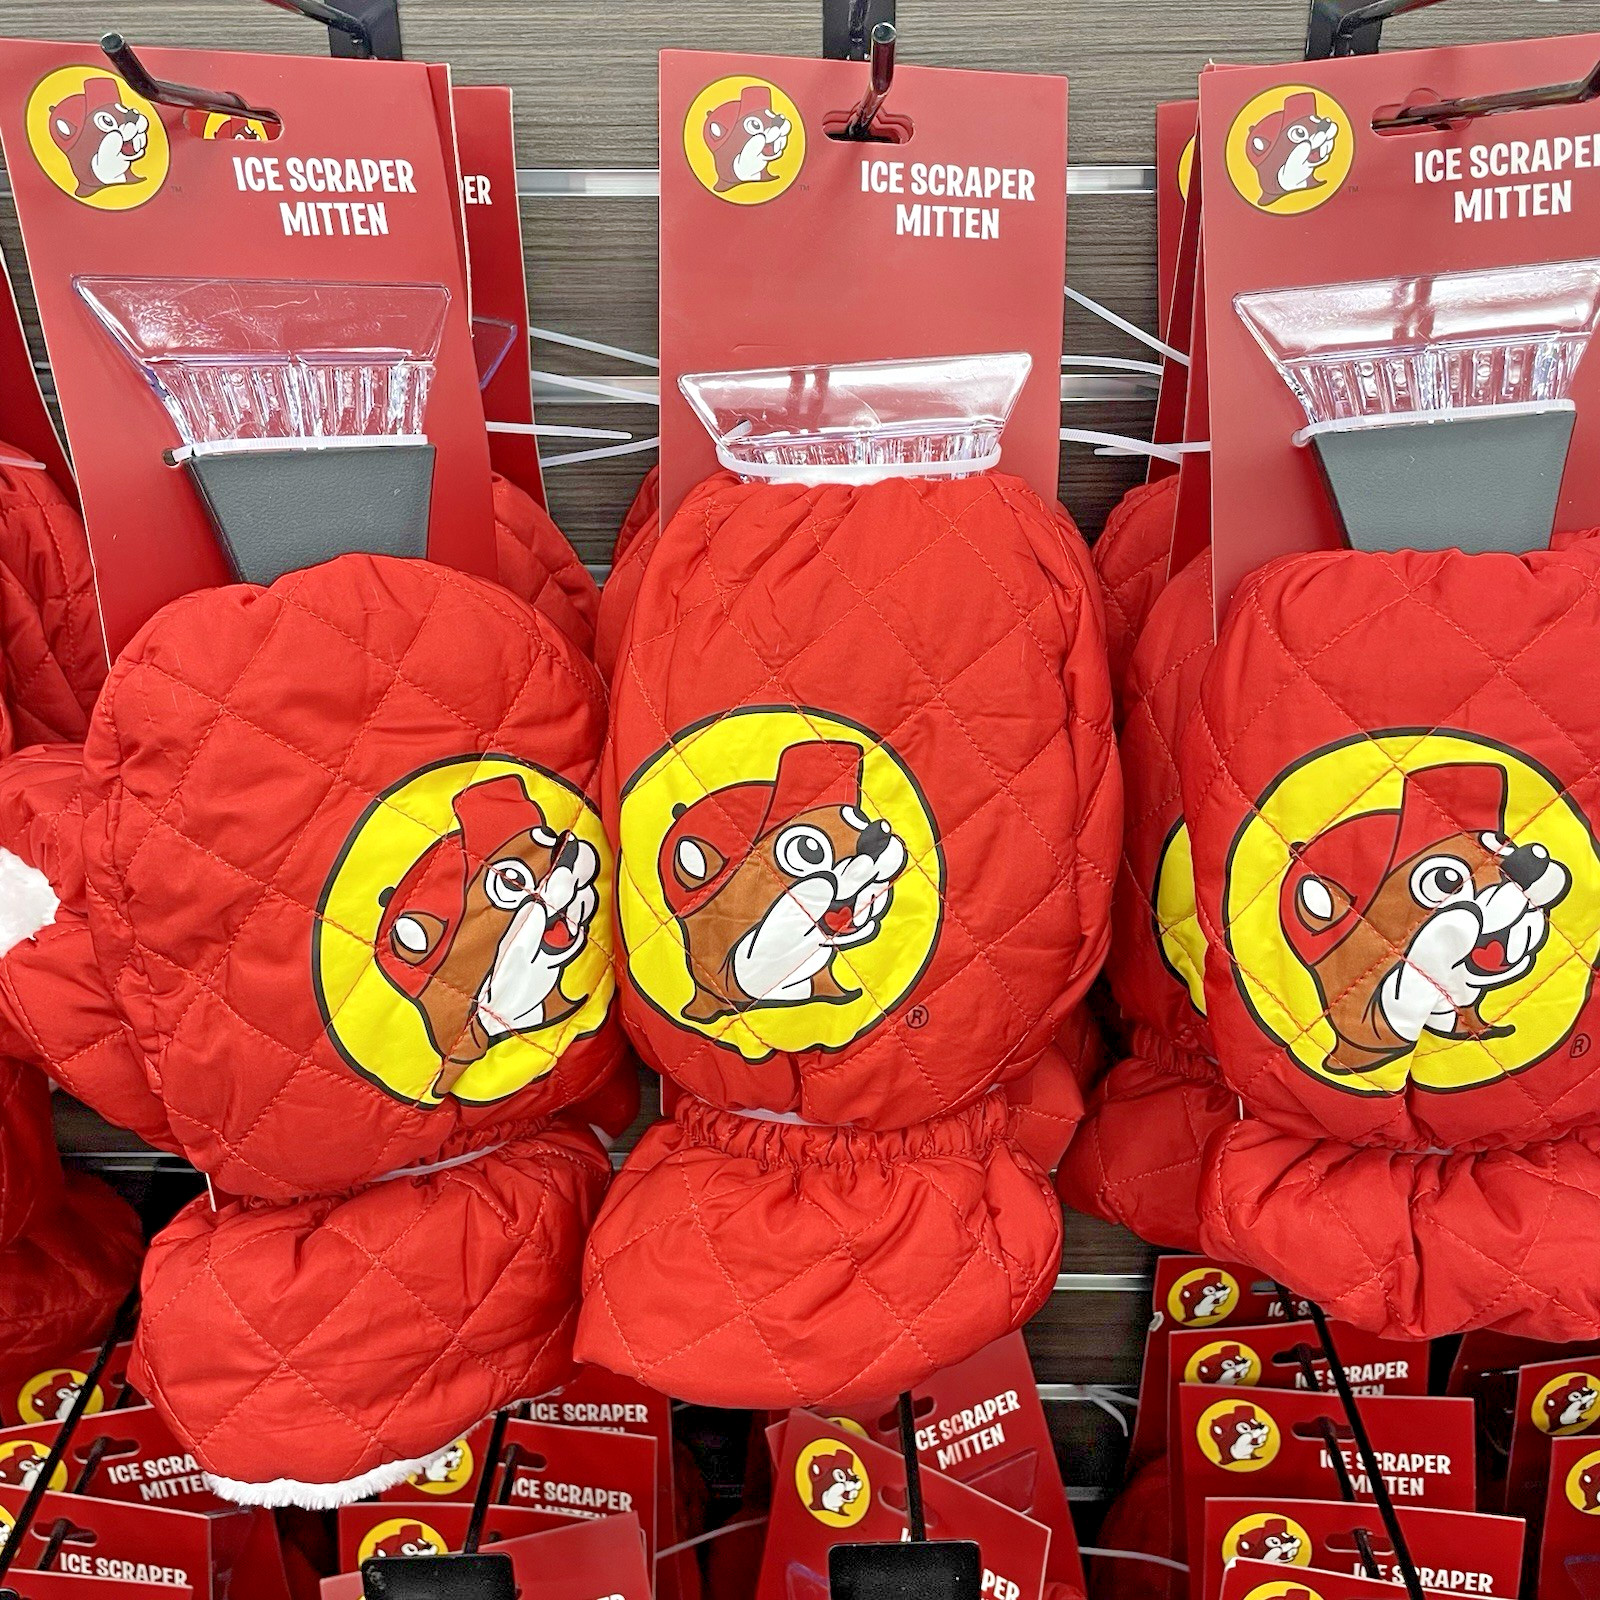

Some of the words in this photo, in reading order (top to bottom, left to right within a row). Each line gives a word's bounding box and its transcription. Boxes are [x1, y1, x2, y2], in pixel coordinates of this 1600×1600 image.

[232, 156, 284, 191] ICE
[286, 157, 417, 193] SCRAPER
[861, 160, 905, 194] ICE
[910, 162, 1036, 201] SCRAPER
[1414, 147, 1463, 184] ICE
[279, 201, 389, 236] MITTEN
[1454, 180, 1572, 223] MITTEN
[896, 203, 1000, 240] MITTEN
[530, 1403, 560, 1421] ICE
[562, 1403, 649, 1423] SCRAPER
[915, 1424, 940, 1451] CE
[938, 1390, 1021, 1440] SCRAPER
[936, 1422, 1006, 1471] MITTEN
[107, 1462, 143, 1485] ICE
[1349, 1474, 1425, 1496] MITEN
[543, 1481, 633, 1512] SCRAPER
[60, 1552, 93, 1574] ICE
[95, 1557, 188, 1586] SCRAPER
[1391, 1564, 1494, 1594] SRAPER
